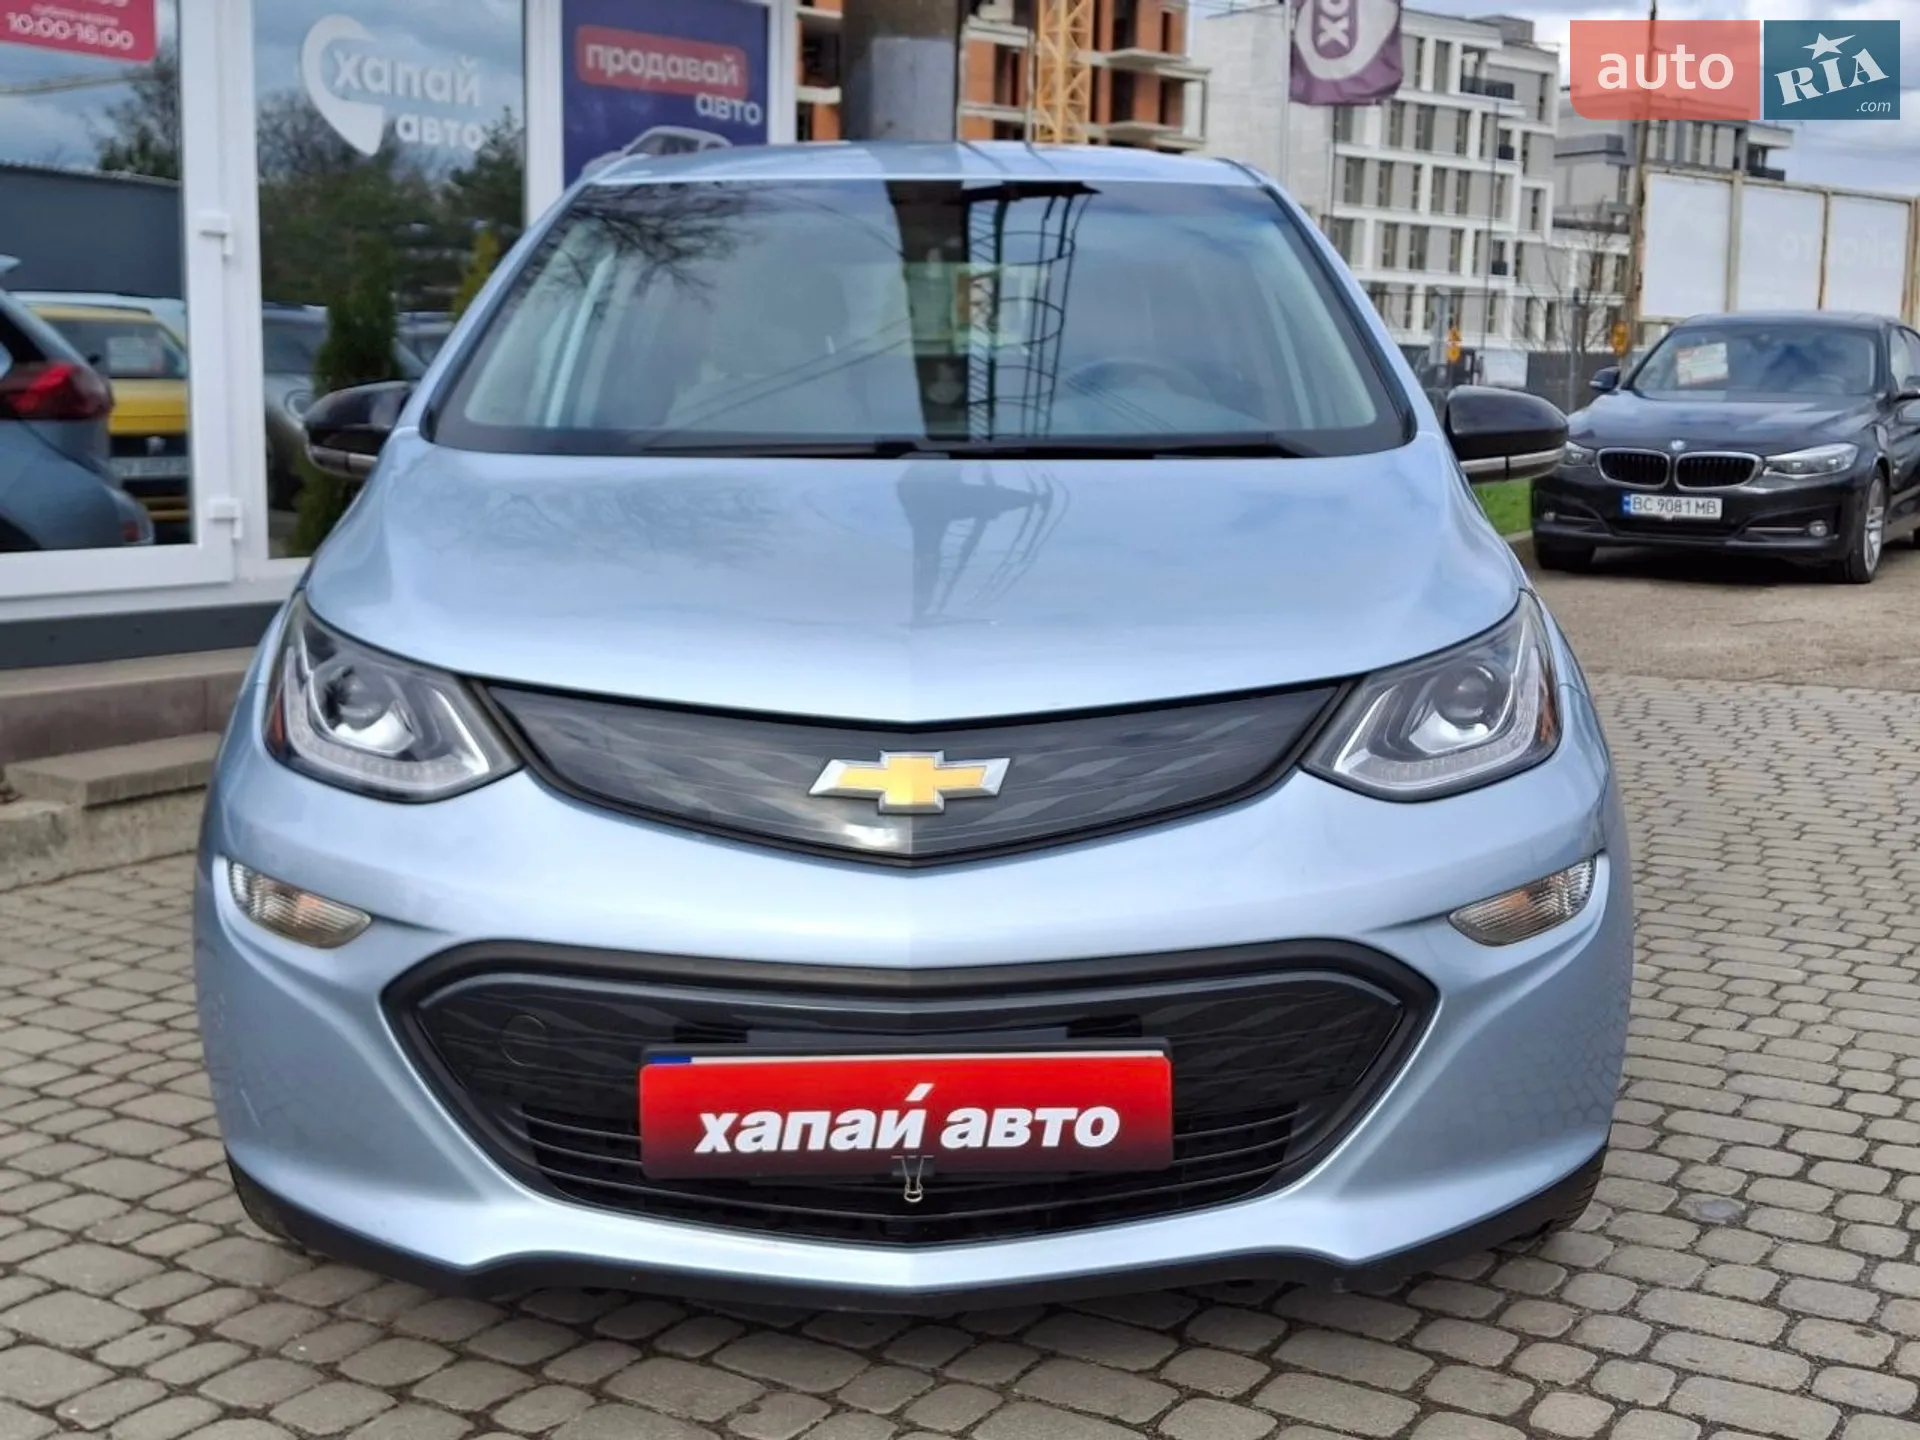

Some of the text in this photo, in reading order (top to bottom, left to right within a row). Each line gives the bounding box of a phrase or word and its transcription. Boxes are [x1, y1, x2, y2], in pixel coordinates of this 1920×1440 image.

[333, 49, 481, 108] хапай
[584, 43, 740, 87] продавай
[695, 83, 763, 127] авто
[396, 113, 485, 151] авто
[1657, 498, 1692, 514] 9081
[940, 1106, 1121, 1149] авто
